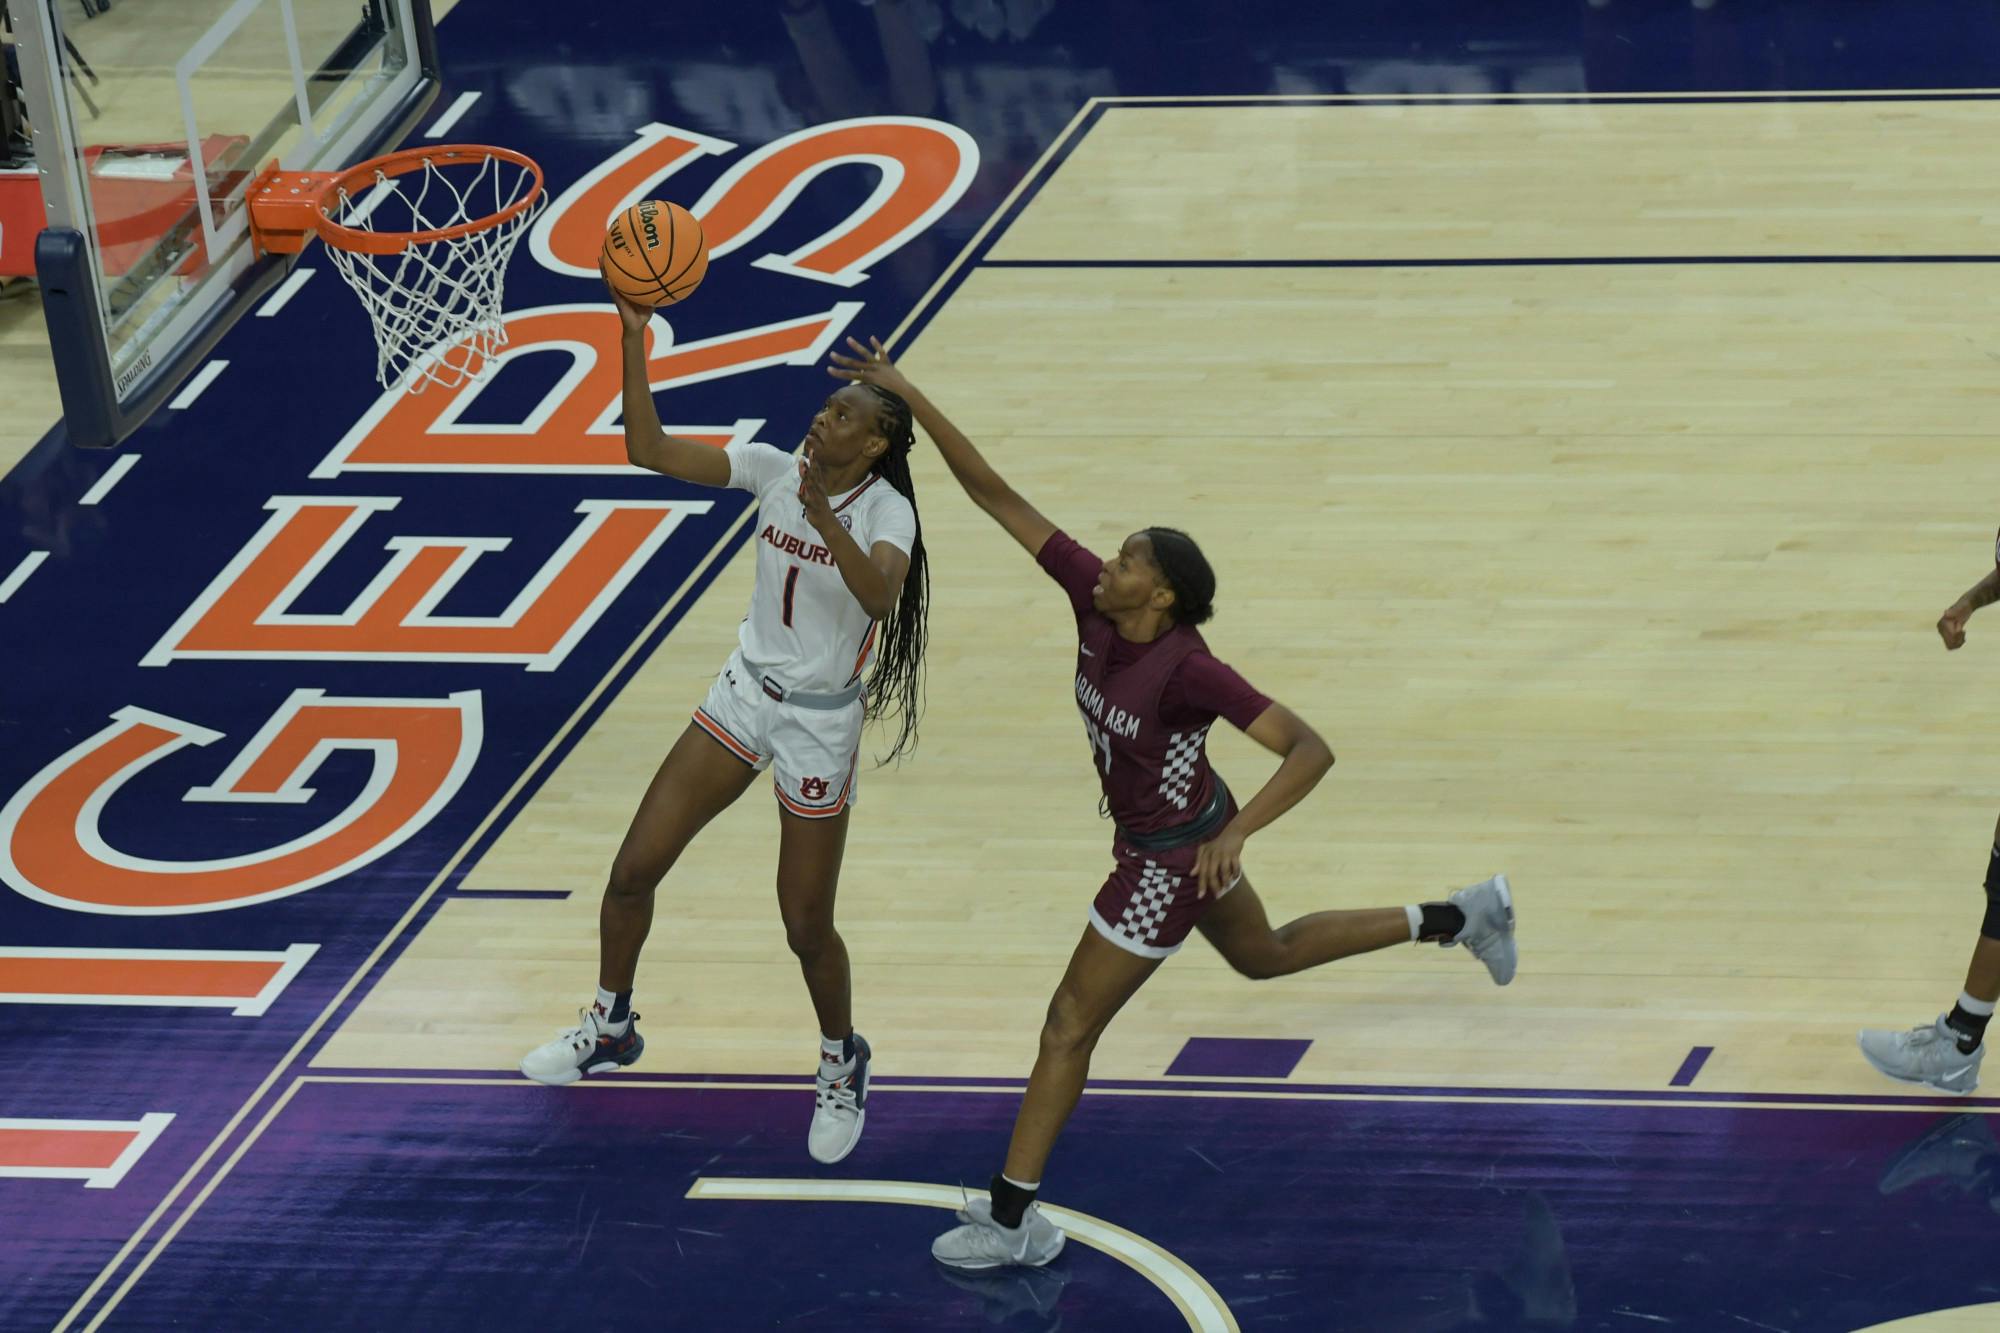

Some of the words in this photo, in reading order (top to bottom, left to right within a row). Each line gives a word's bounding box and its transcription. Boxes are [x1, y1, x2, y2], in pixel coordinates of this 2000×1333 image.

[117, 348, 151, 398] SPALDING
[783, 565, 800, 629] 1
[1104, 704, 1141, 740] A&M
